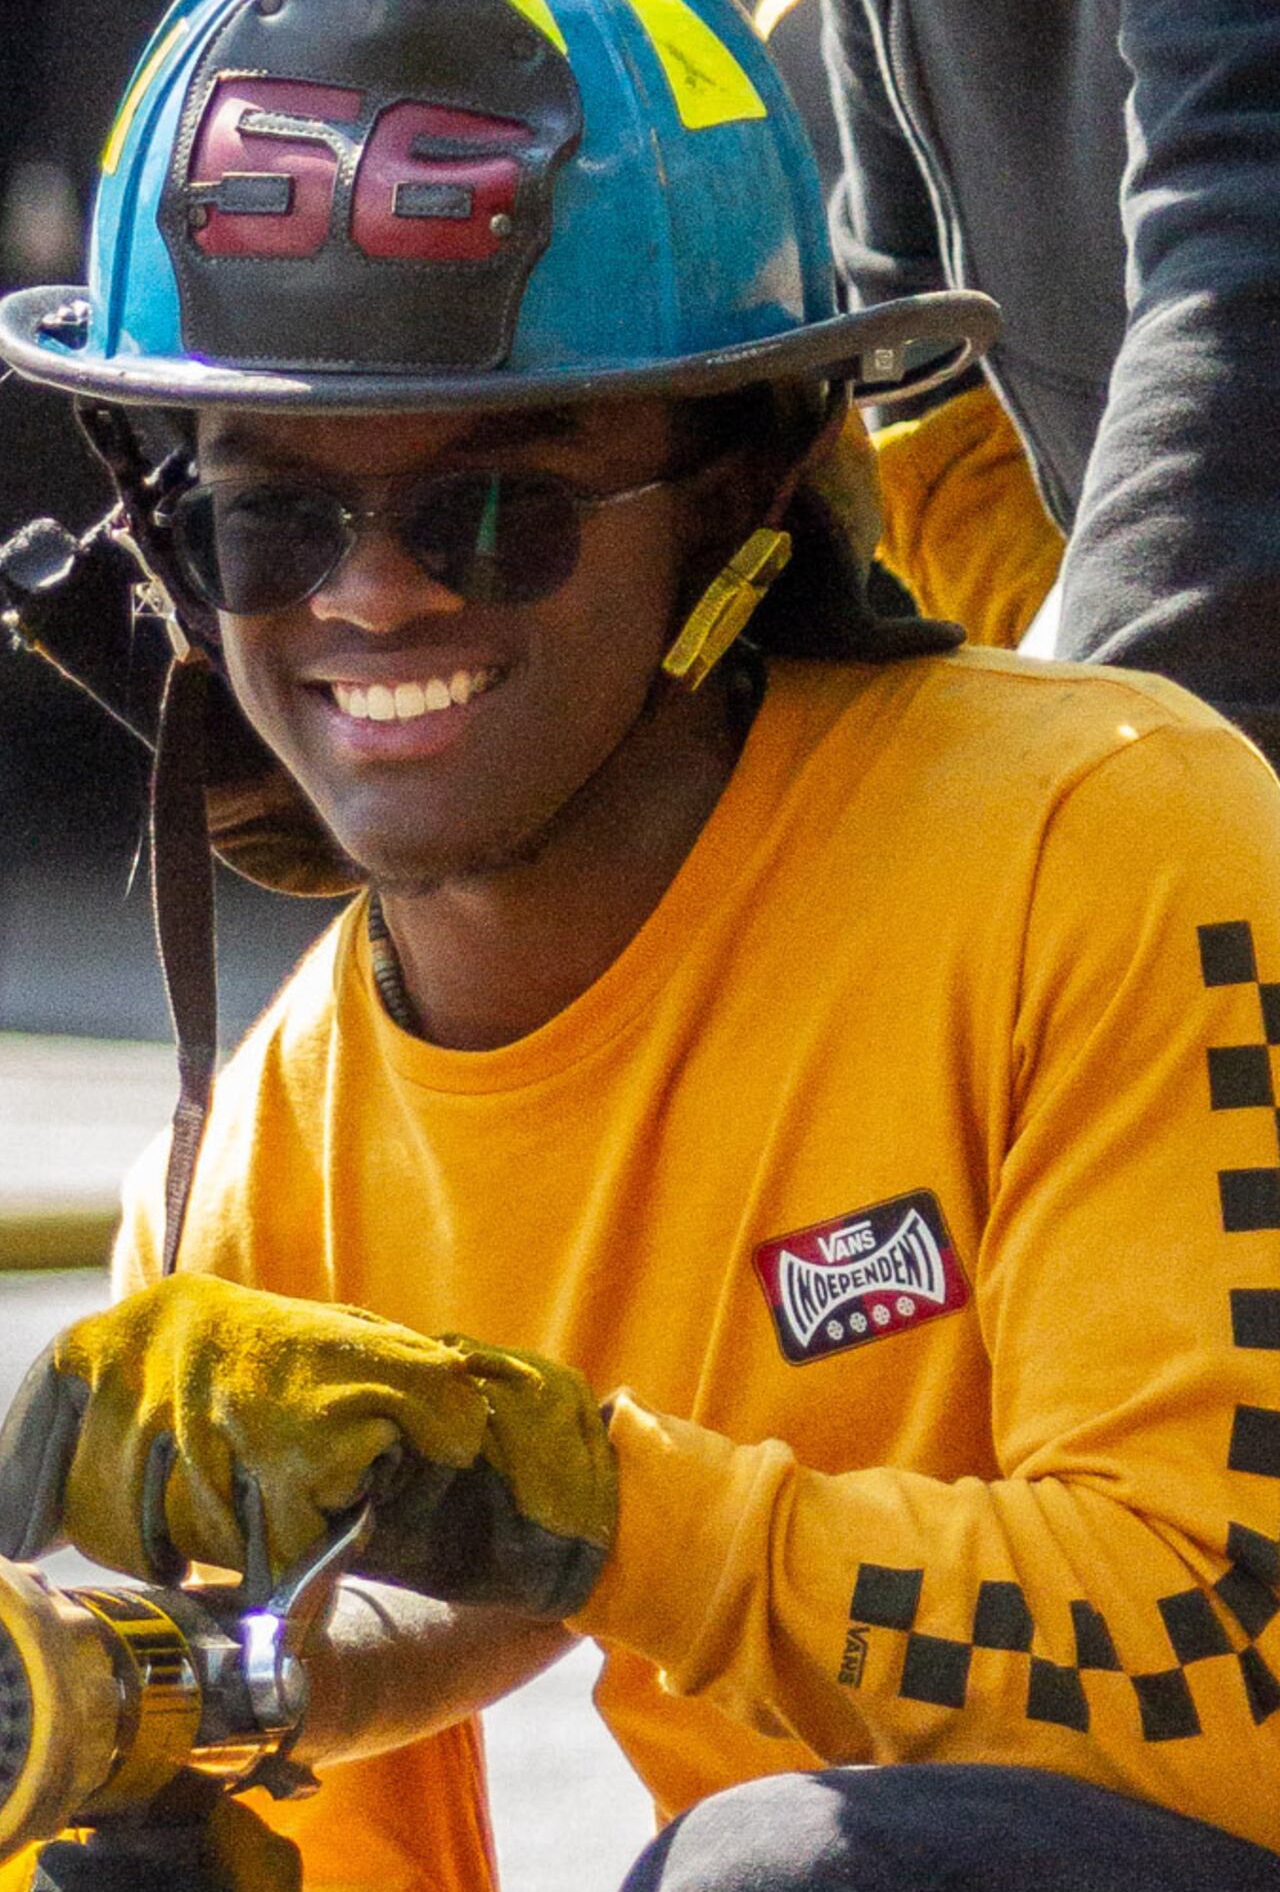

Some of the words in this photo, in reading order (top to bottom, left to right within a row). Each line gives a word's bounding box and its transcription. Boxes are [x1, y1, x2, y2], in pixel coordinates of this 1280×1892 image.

[187, 77, 535, 261] 56
[787, 1215, 936, 1336] INDEPENDENT
[818, 1219, 877, 1264] VANS
